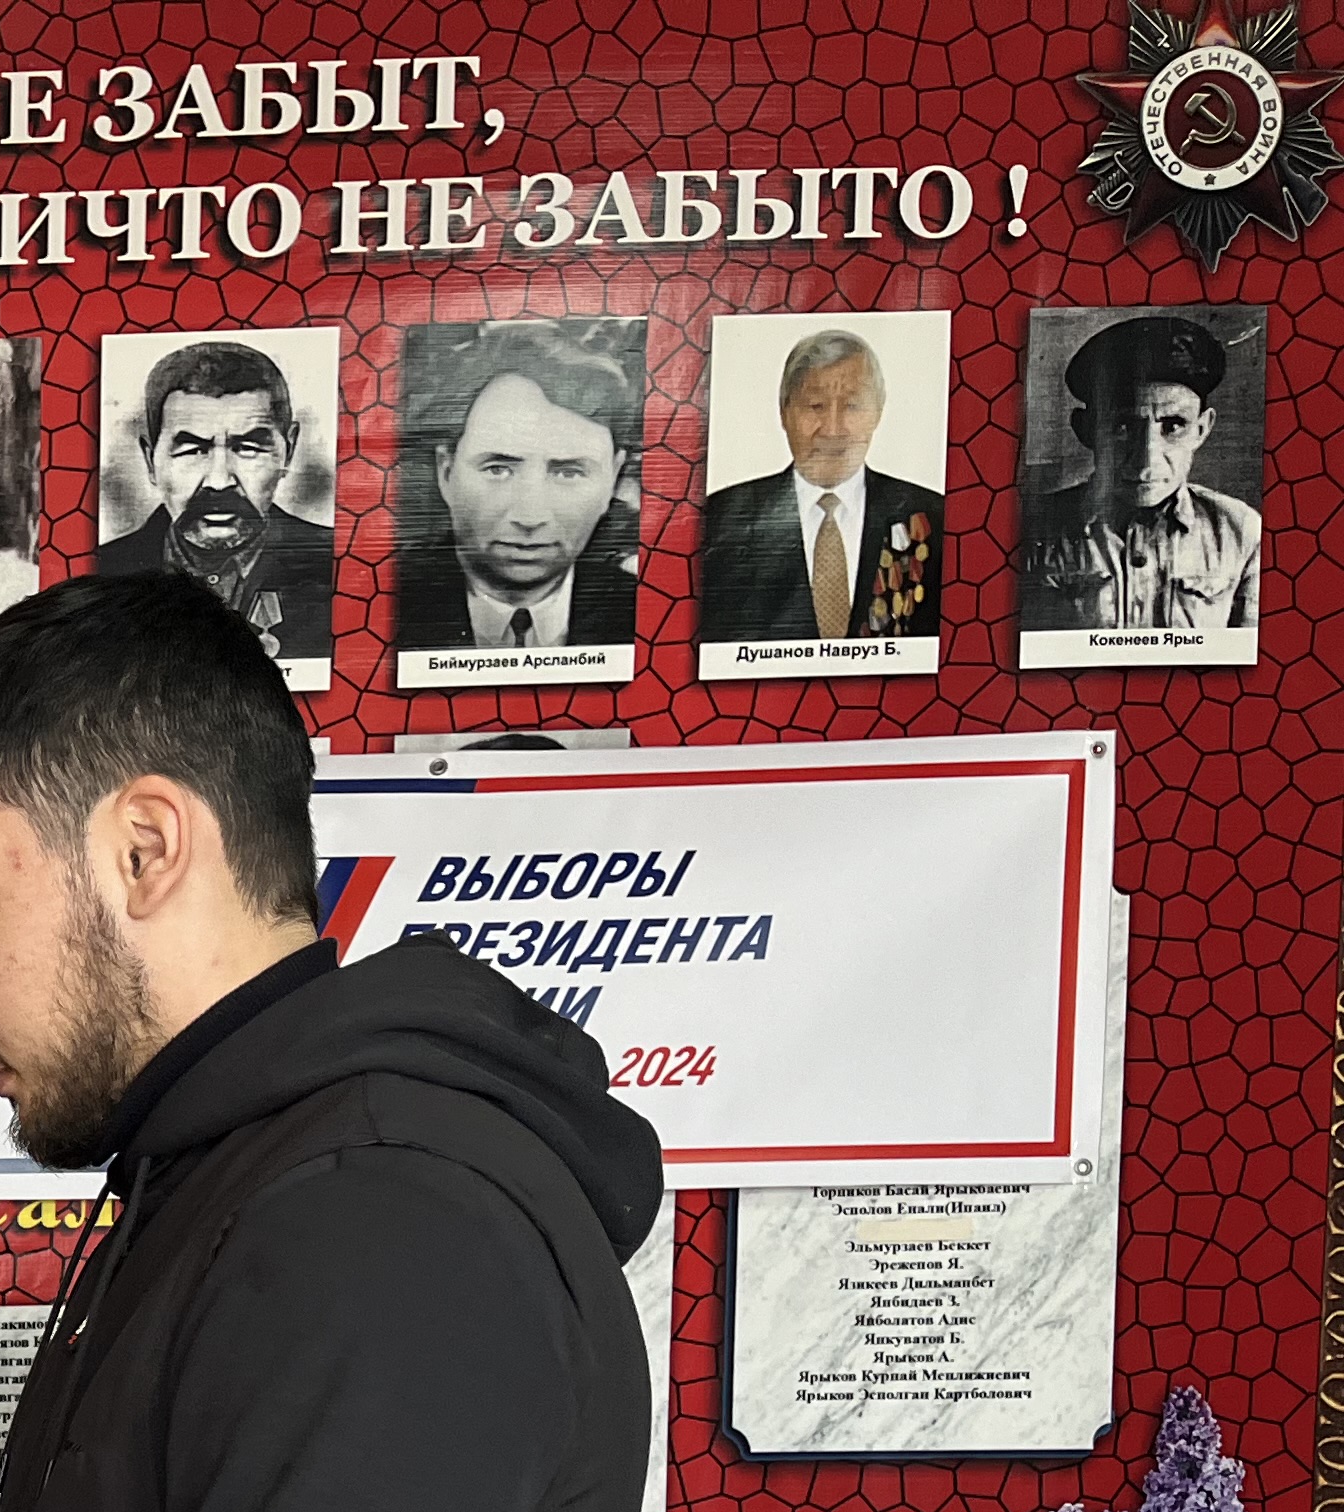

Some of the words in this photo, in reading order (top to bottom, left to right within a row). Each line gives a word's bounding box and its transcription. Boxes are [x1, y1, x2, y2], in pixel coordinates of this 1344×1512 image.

[92, 55, 506, 146] ЗАБЫТ,
[1147, 52, 1267, 176] ОТЕЧЕСТВЕННАЯ
[330, 176, 486, 254] НЕ
[514, 165, 974, 248] ЗАБЫТО
[1007, 164, 1029, 238] !
[1088, 633, 1161, 648] Кокенеев
[1164, 632, 1205, 649] Ярыс
[736, 644, 815, 663] Душанов
[819, 642, 881, 660] Навруз
[884, 642, 902, 655] Б.
[428, 656, 519, 672] Биймурзаев
[522, 652, 606, 669] Арсланбий
[416, 850, 698, 903] ВЫБОРЫ
[608, 1045, 717, 1088] 2024
[844, 1240, 934, 1255] Эльмурзаев
[947, 1257, 965, 1270] Я.
[949, 1331, 965, 1344] Б.
[873, 1351, 934, 1367] Ярыков
[938, 1350, 955, 1363] А.
[798, 1370, 858, 1386] Ярыков
[796, 1389, 855, 1404] Ярыков
